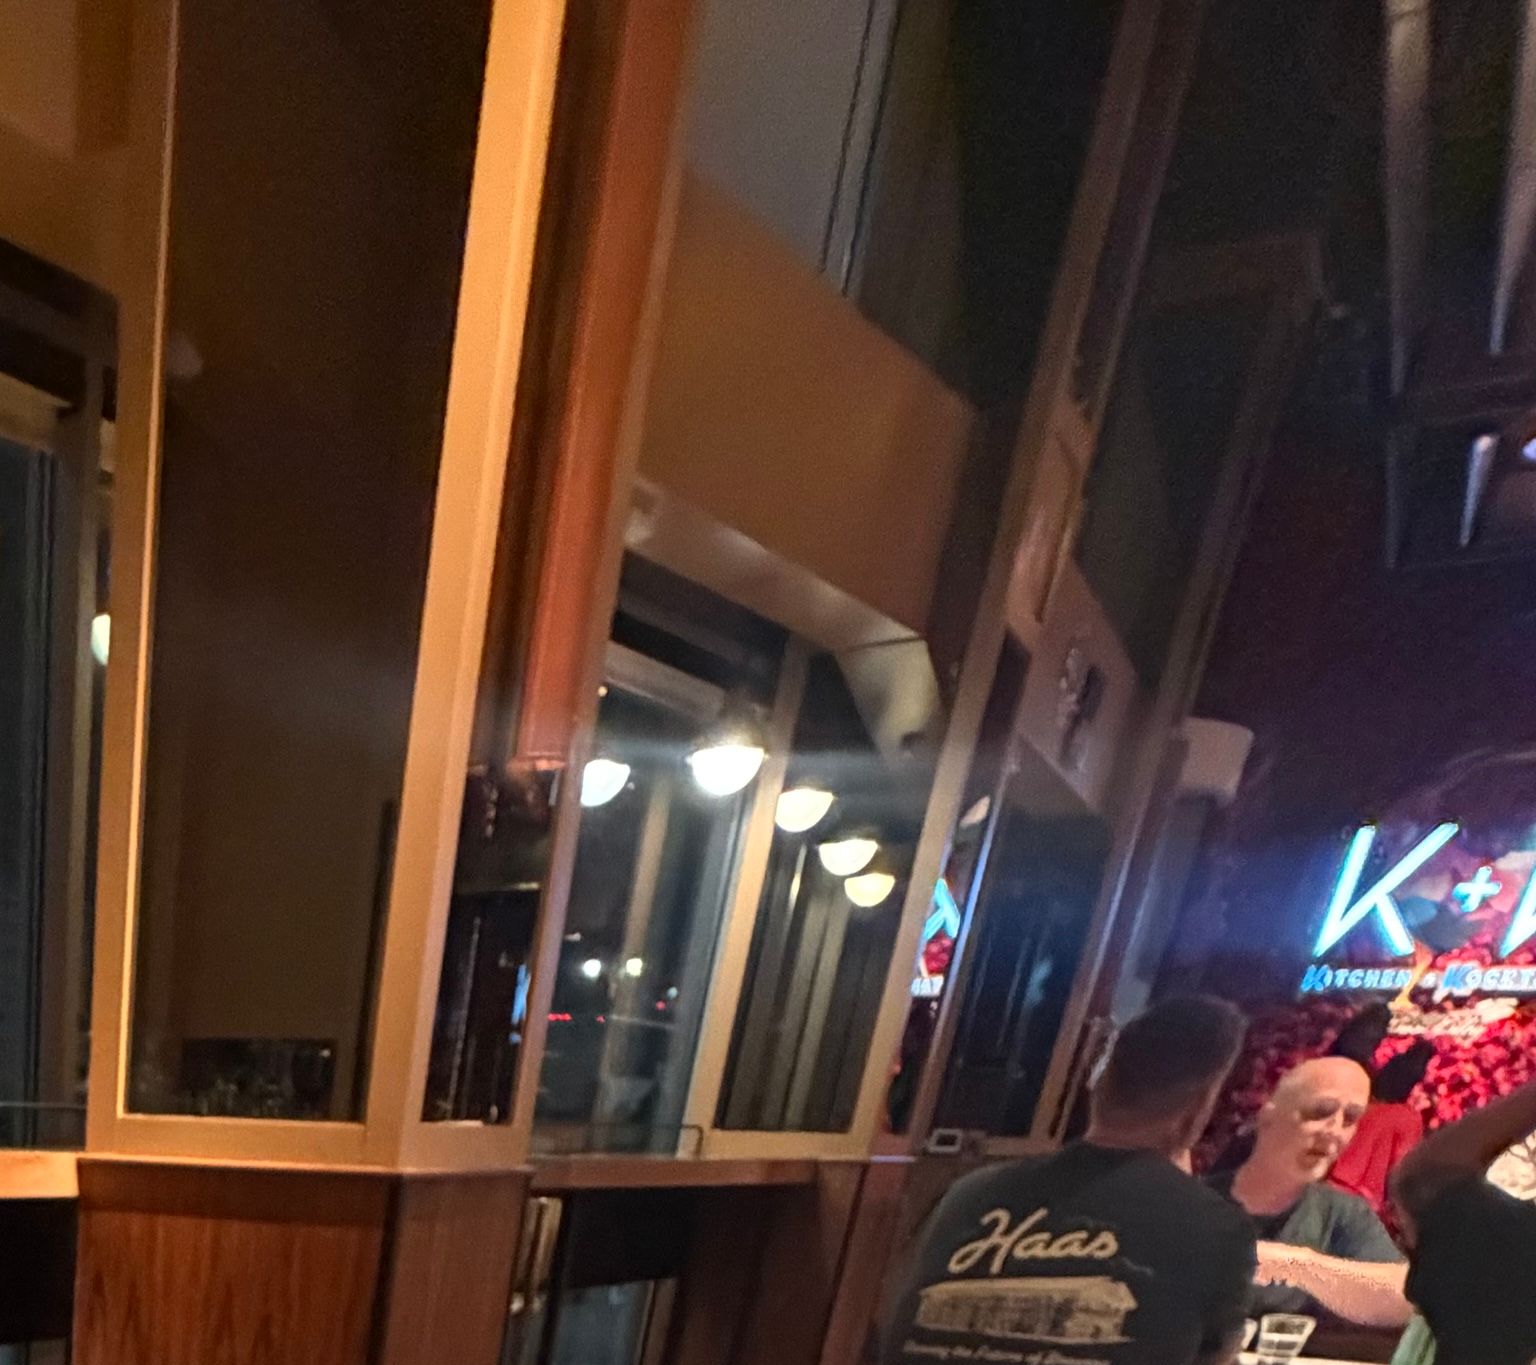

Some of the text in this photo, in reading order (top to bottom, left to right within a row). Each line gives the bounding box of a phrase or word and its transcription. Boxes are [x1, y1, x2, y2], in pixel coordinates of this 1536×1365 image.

[1314, 822, 1459, 958] K
[1442, 963, 1536, 992] KOCKT
[947, 1207, 1119, 1274] Haas
